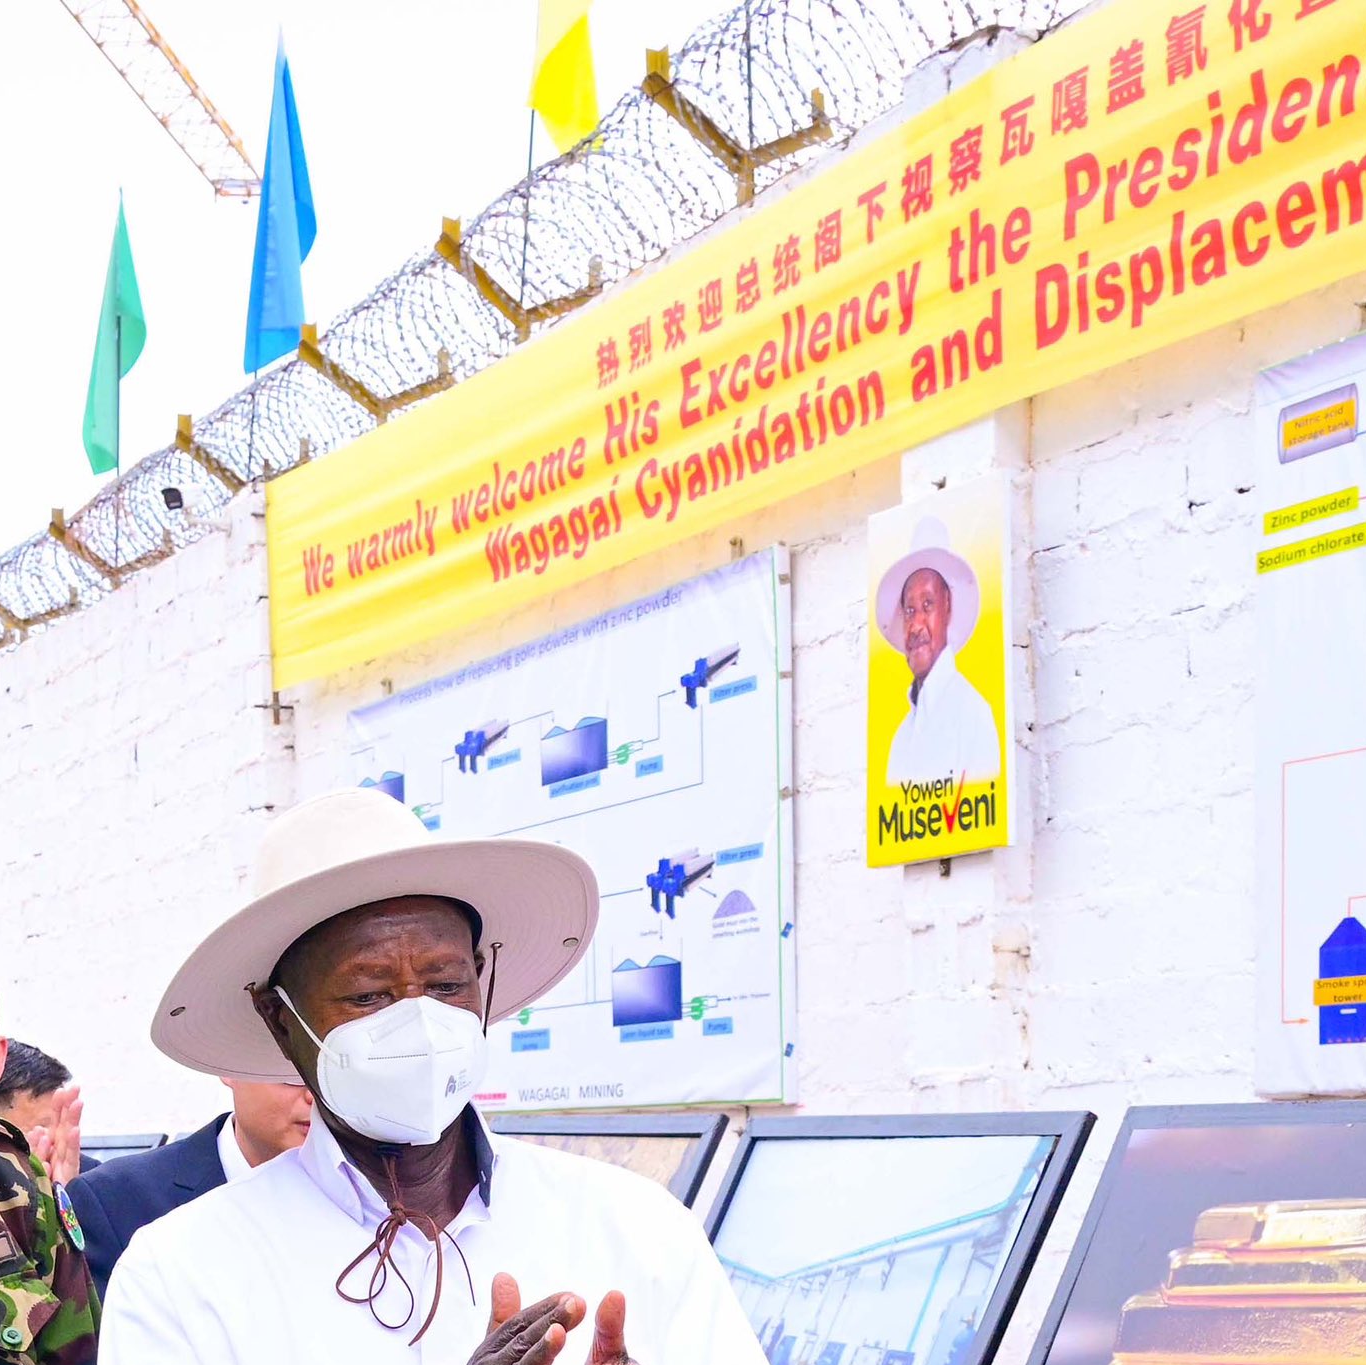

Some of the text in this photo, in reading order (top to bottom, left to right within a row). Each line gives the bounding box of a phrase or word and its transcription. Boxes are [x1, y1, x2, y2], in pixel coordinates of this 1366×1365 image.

[303, 543, 333, 596] We
[348, 500, 437, 578] warmly
[452, 437, 585, 534] welcome
[605, 391, 659, 464] His
[680, 261, 921, 430] Excellency
[948, 207, 1031, 292] the
[485, 476, 622, 583] Wagagai
[635, 370, 885, 522] Cyanidation
[911, 288, 1002, 401] and
[1271, 496, 1352, 528] Zinc powder
[1258, 530, 1364, 569] Sodium chlorate
[901, 770, 953, 805] Yoweri
[879, 774, 995, 845] Museveni
[1317, 978, 1346, 989] Smoke
[1333, 991, 1363, 1003] tower
[518, 1085, 569, 1102] WAGAGAI
[579, 1083, 624, 1099] MINING
